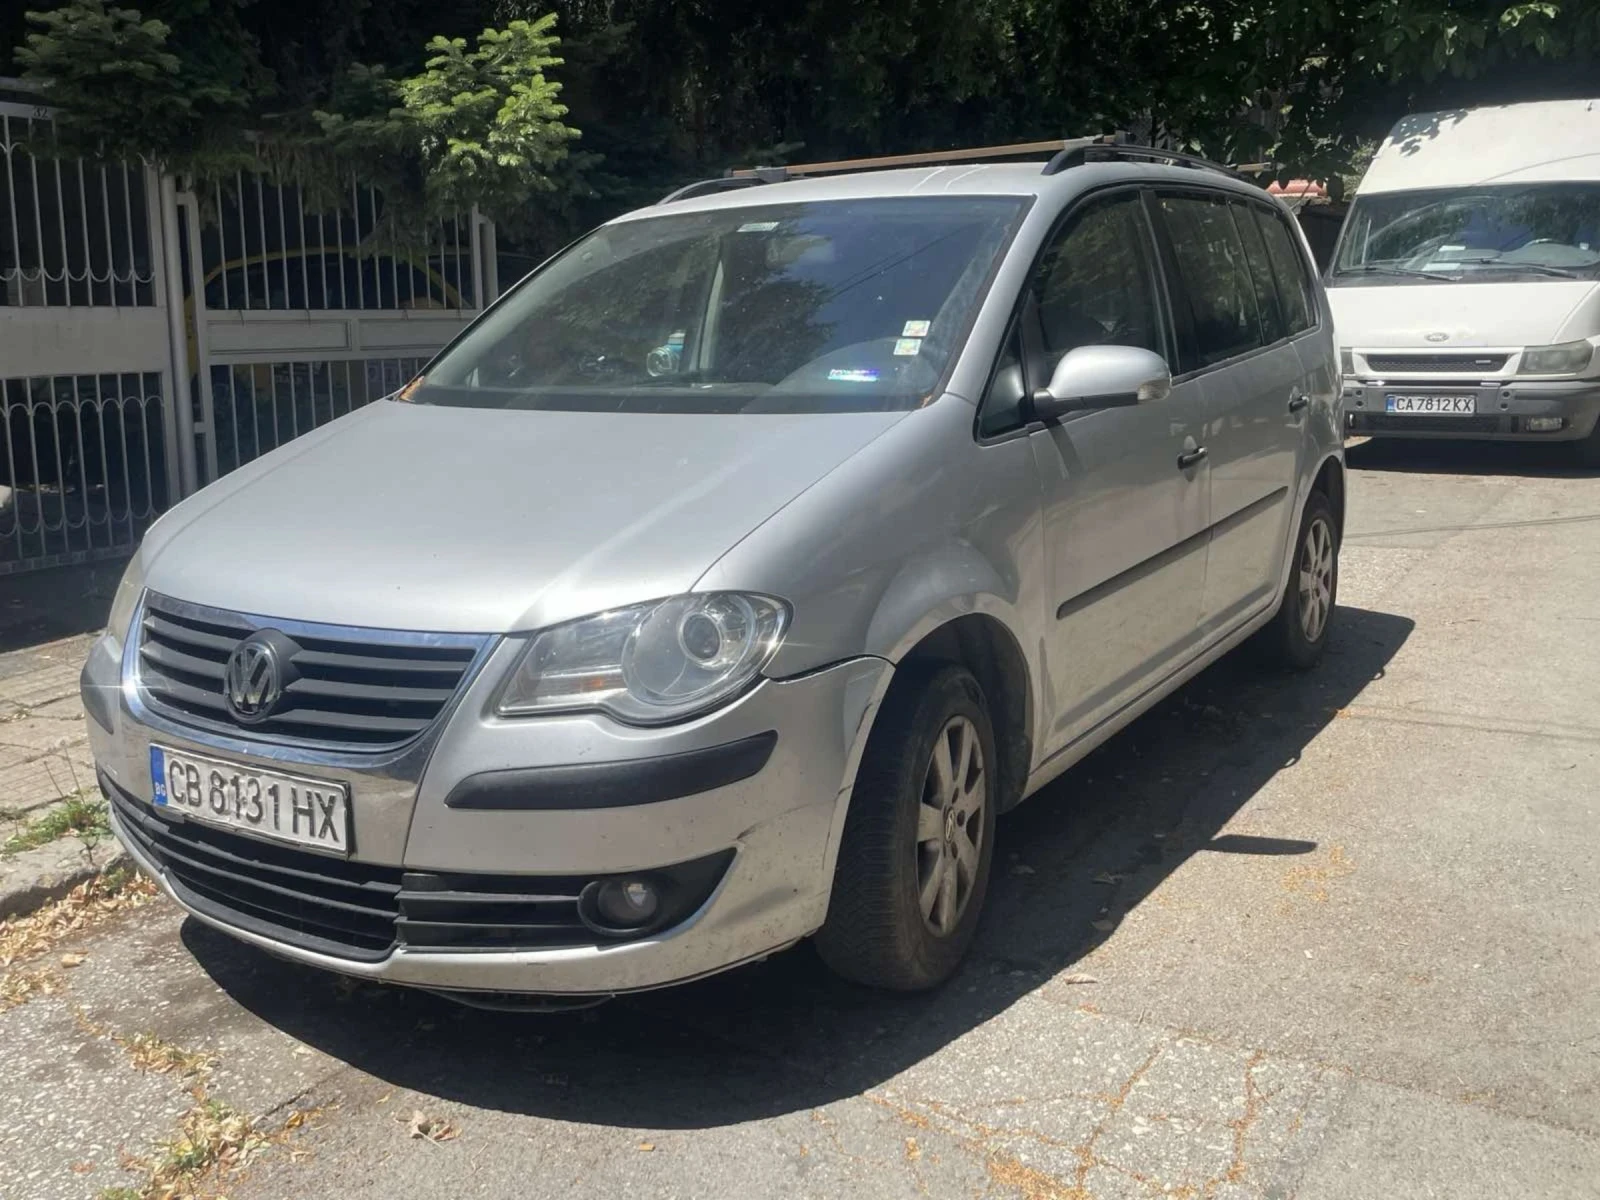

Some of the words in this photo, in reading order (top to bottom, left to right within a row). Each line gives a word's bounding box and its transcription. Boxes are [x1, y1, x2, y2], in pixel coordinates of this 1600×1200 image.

[1396, 398, 1414, 411] CA
[1417, 398, 1451, 412] 7812
[1453, 398, 1472, 412] KX
[227, 643, 278, 718] VW
[169, 758, 203, 808] CB
[208, 768, 282, 831] 8131
[291, 785, 340, 843] HX
